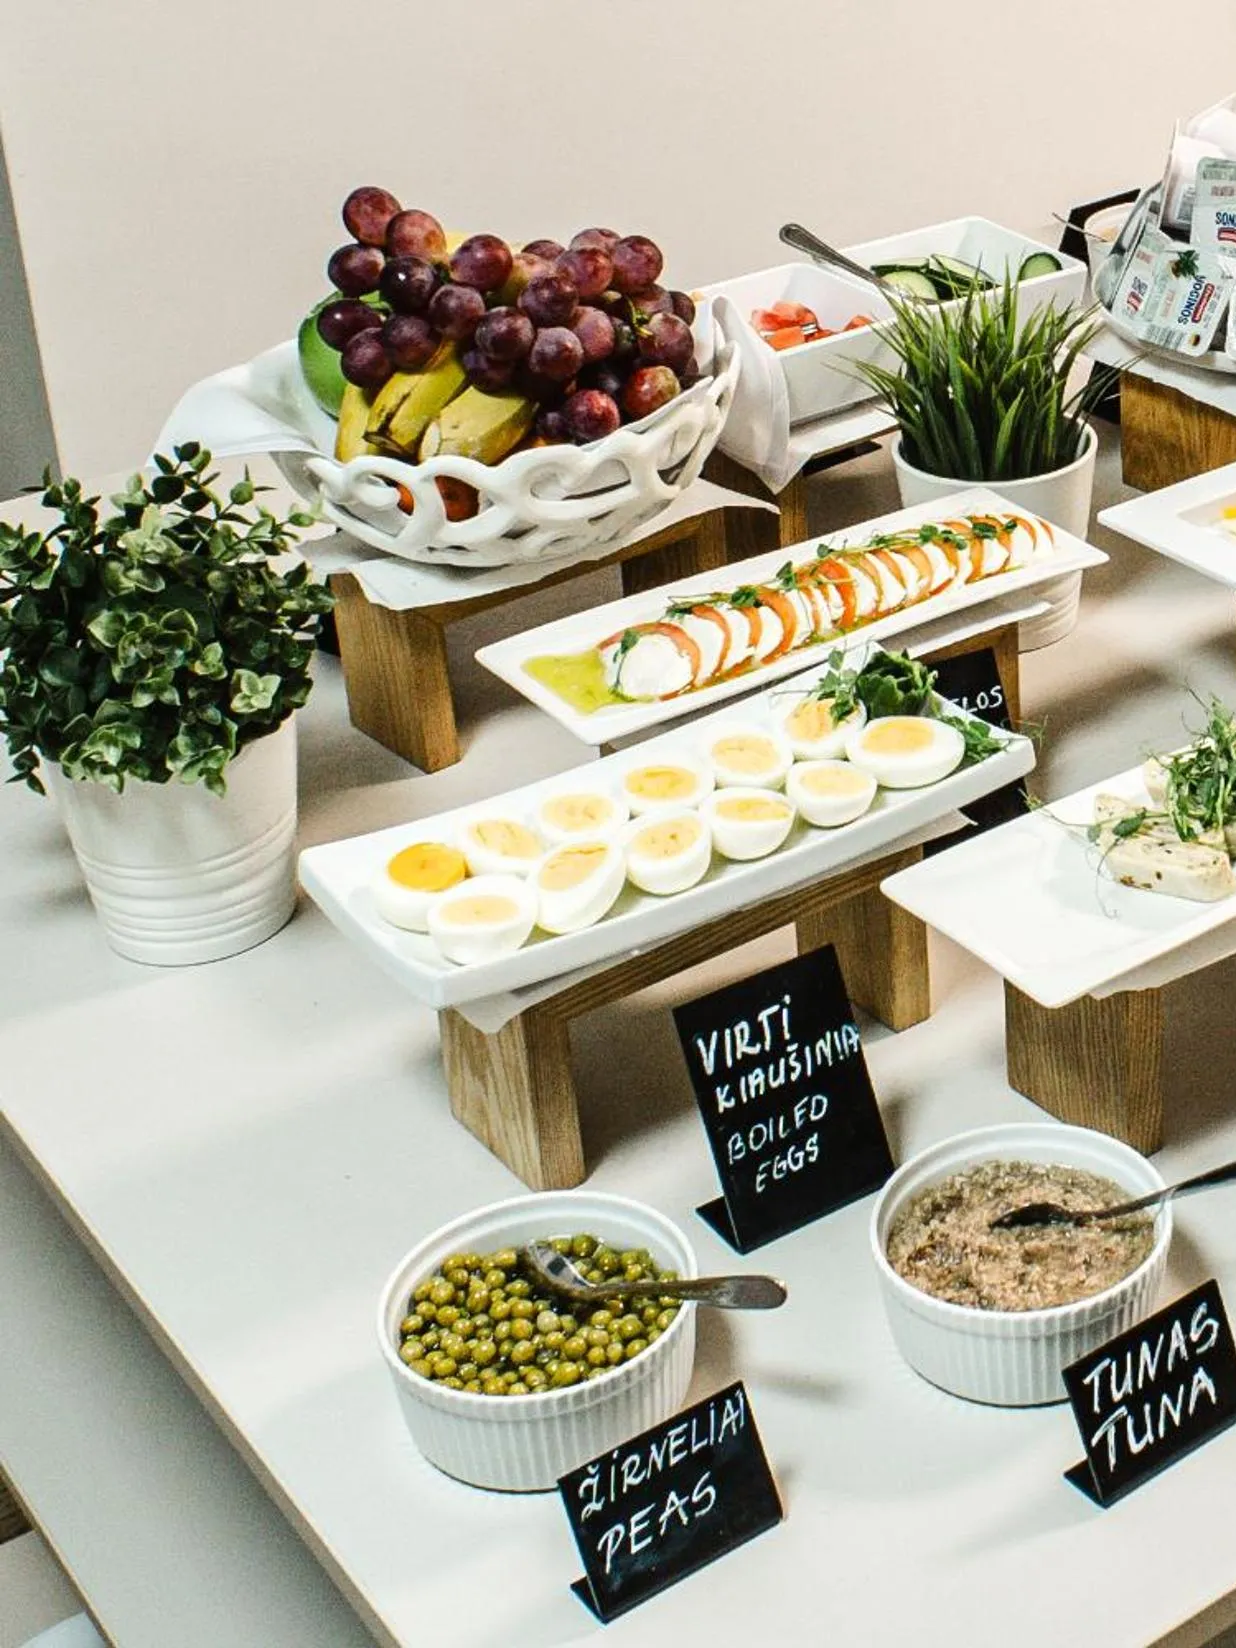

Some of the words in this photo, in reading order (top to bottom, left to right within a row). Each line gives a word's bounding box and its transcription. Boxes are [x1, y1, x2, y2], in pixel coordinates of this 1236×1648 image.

[697, 994, 791, 1076] VIRTI
[727, 1094, 828, 1165] BOILED
[755, 1132, 819, 1193] EGGS
[1082, 1301, 1219, 1413] TUNAS
[578, 1390, 745, 1522] ŽIRNELIAI
[1091, 1365, 1217, 1473] TUNA
[597, 1471, 716, 1574] PEAS
